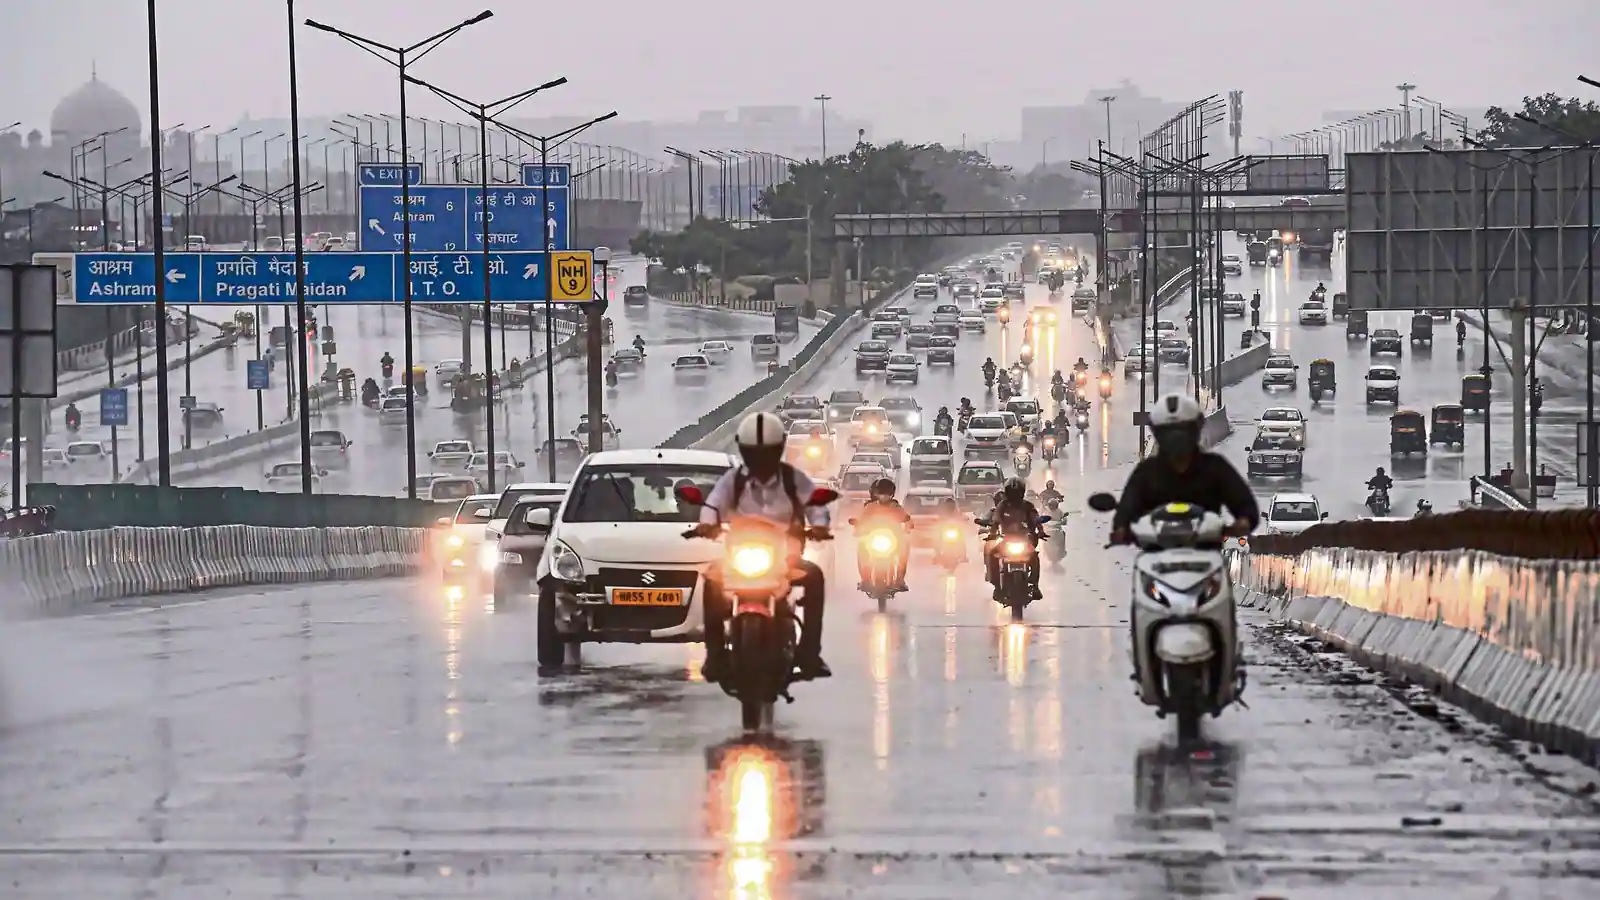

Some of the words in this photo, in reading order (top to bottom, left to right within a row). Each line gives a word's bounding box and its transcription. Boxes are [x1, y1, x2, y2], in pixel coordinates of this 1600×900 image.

[379, 169, 403, 179] EXIT
[393, 195, 426, 206] अश्रम
[503, 192, 516, 206] टी
[521, 193, 536, 206] ओ
[446, 201, 454, 211] 6
[548, 201, 555, 212] 5
[474, 211, 494, 222] ITO
[474, 233, 519, 244] रजघाट
[88, 260, 134, 276] आश्रम
[216, 255, 257, 276] प्रगति
[561, 266, 583, 278] NH
[89, 281, 156, 296] Ashram
[569, 279, 578, 290] 9
[216, 282, 280, 300] Pragati
[285, 282, 347, 296] Maidan
